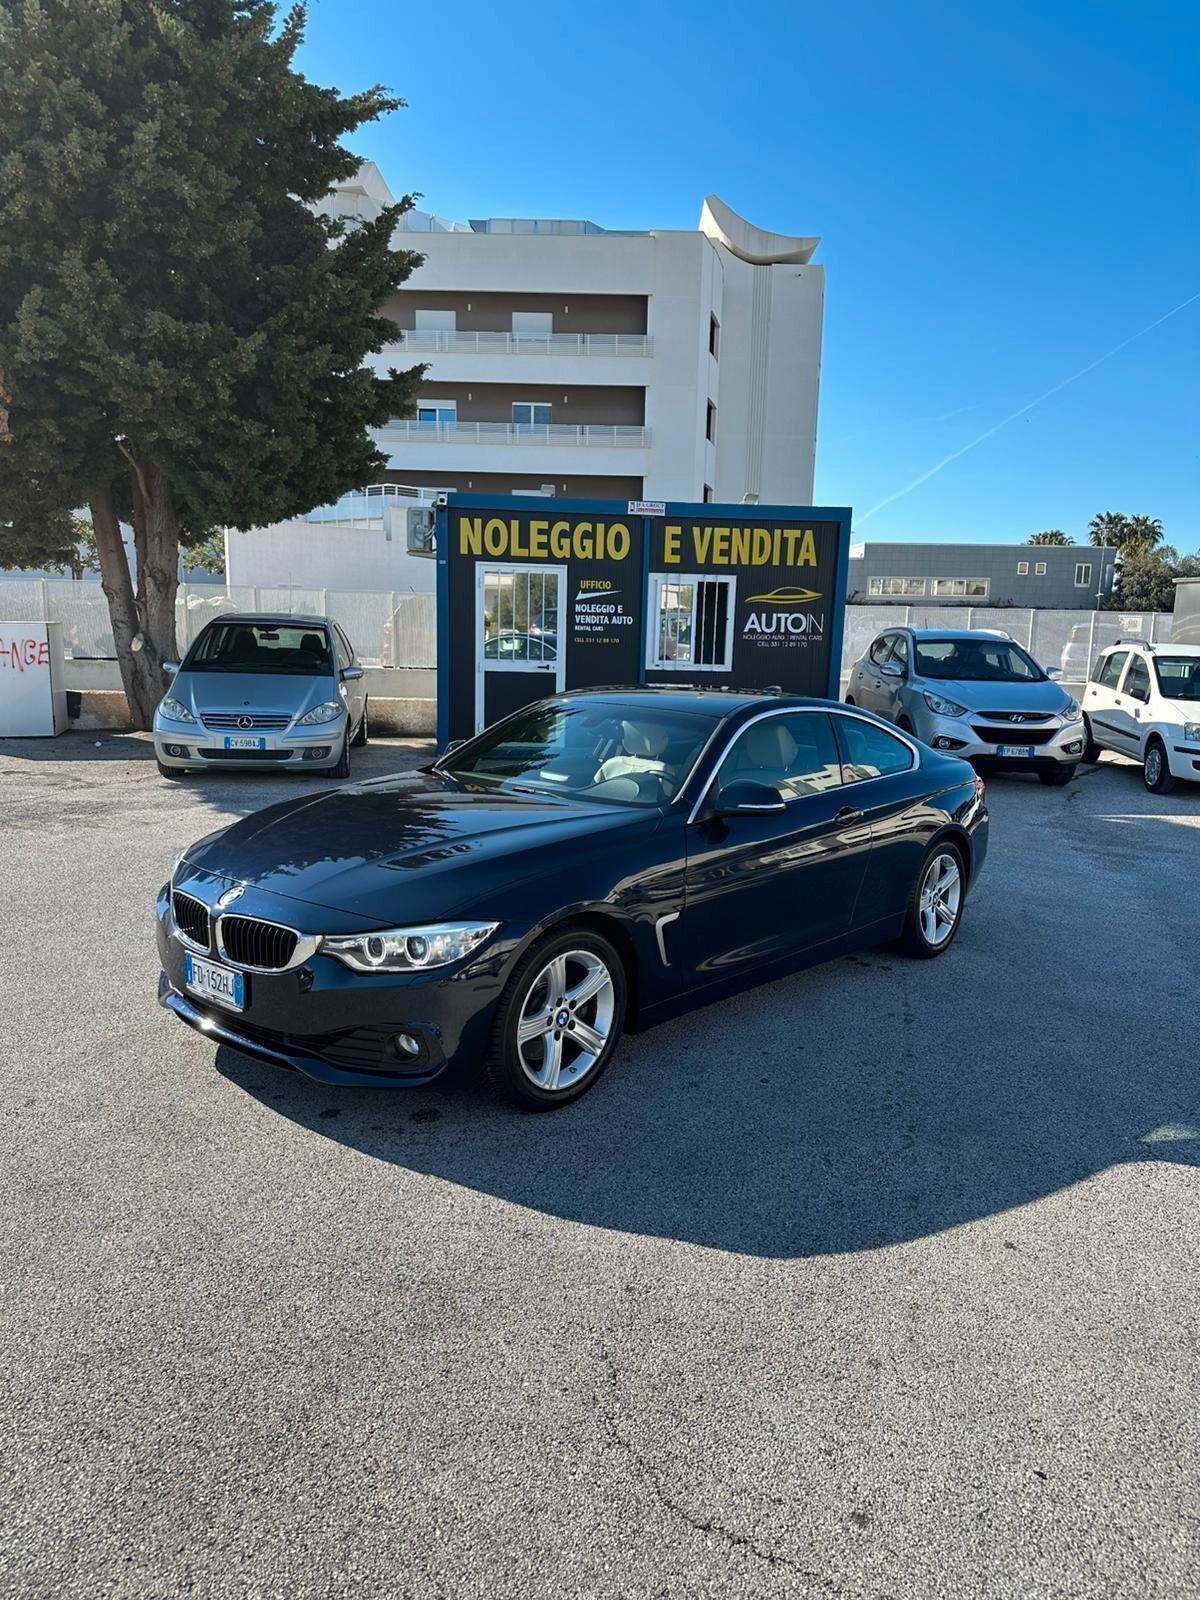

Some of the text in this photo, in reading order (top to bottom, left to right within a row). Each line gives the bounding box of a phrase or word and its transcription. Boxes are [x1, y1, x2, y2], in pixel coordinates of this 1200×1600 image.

[459, 517, 817, 567] NOLEGGIO E VENDITA
[580, 580, 611, 590] UFFICIO
[575, 604, 623, 614] NOLEGGIO E
[575, 614, 633, 625] VENDITA AUTO
[742, 633, 771, 641] NOLEGGIO
